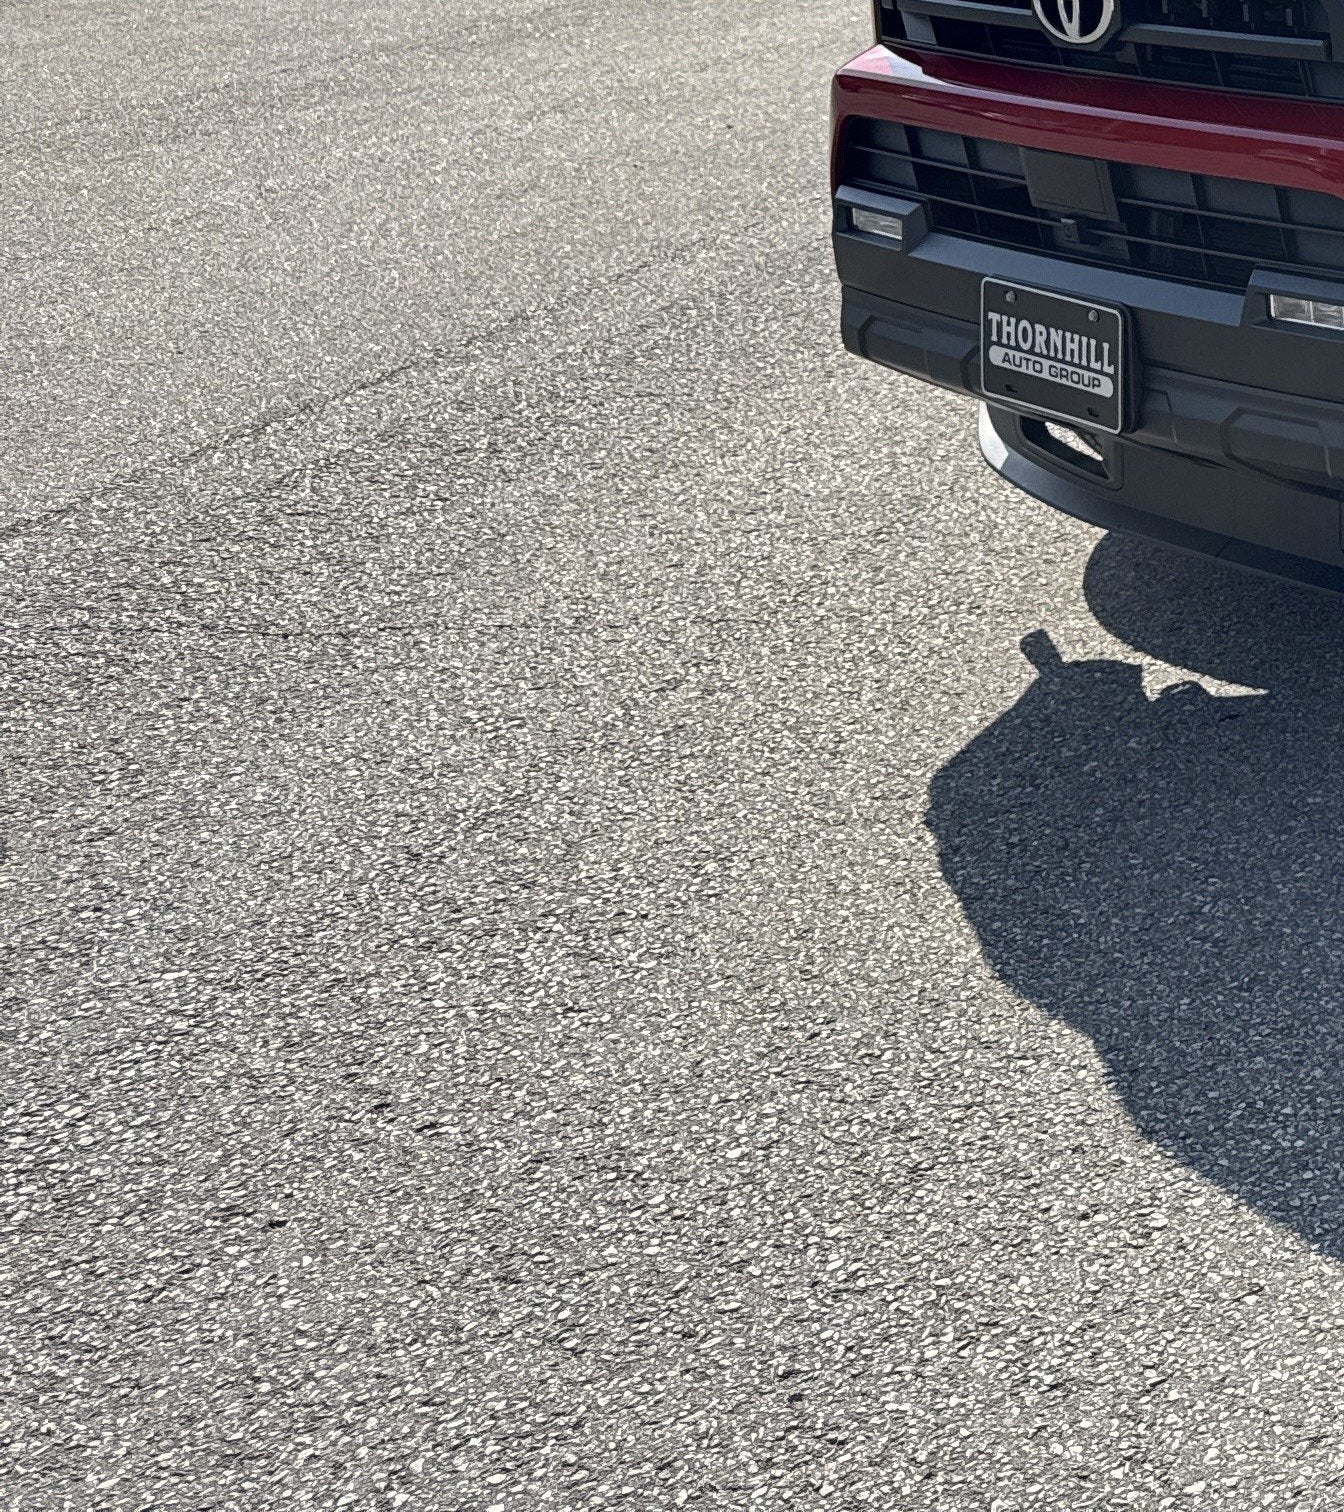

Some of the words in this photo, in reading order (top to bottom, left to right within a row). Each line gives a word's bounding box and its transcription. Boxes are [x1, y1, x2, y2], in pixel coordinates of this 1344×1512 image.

[987, 311, 1115, 375] THORNHILL
[1001, 351, 1043, 374] AUTO
[1048, 363, 1101, 390] GROUP
